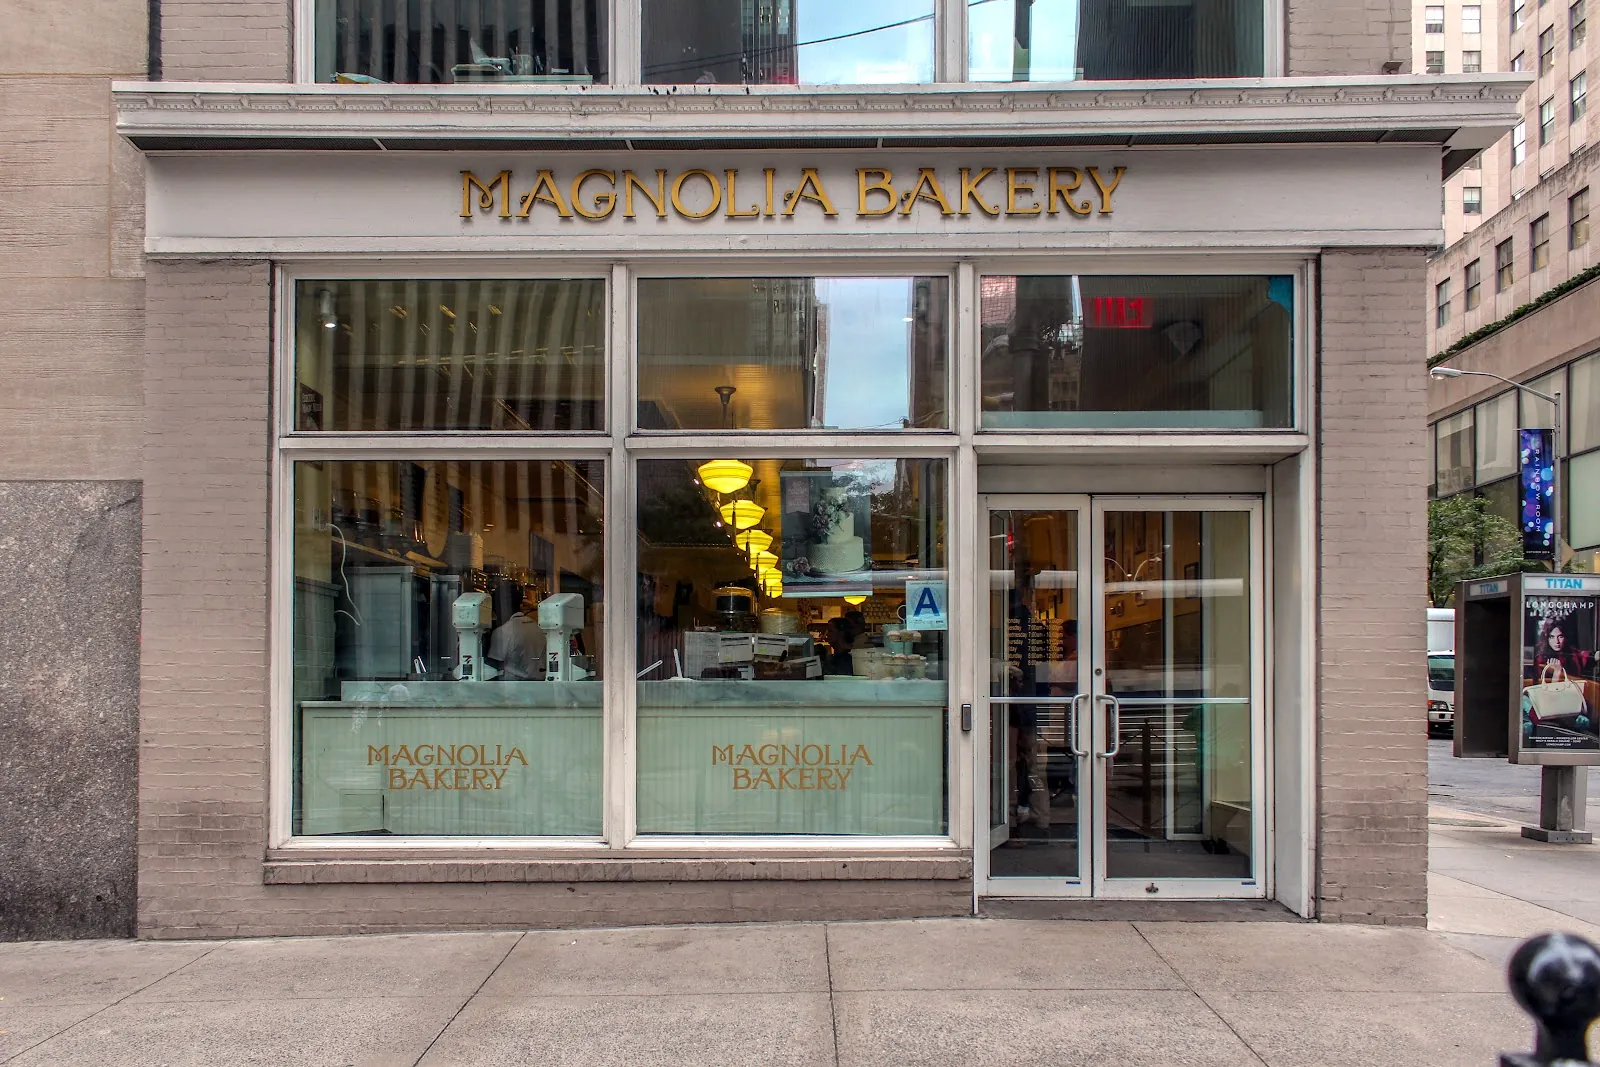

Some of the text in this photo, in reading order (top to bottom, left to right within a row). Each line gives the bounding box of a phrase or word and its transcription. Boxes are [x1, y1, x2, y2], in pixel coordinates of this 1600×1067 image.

[460, 166, 1127, 218] MAGNOLIA BAKERY
[1479, 583, 1499, 594] TITAN
[1545, 578, 1583, 589] TITAN
[913, 587, 940, 617] A
[1526, 601, 1594, 609] LONGCHAMP
[367, 744, 528, 766] MAGNOLIA
[712, 744, 873, 766] MAGNOLIA
[388, 768, 507, 790] BAKERY
[733, 767, 852, 790] BAKERY
